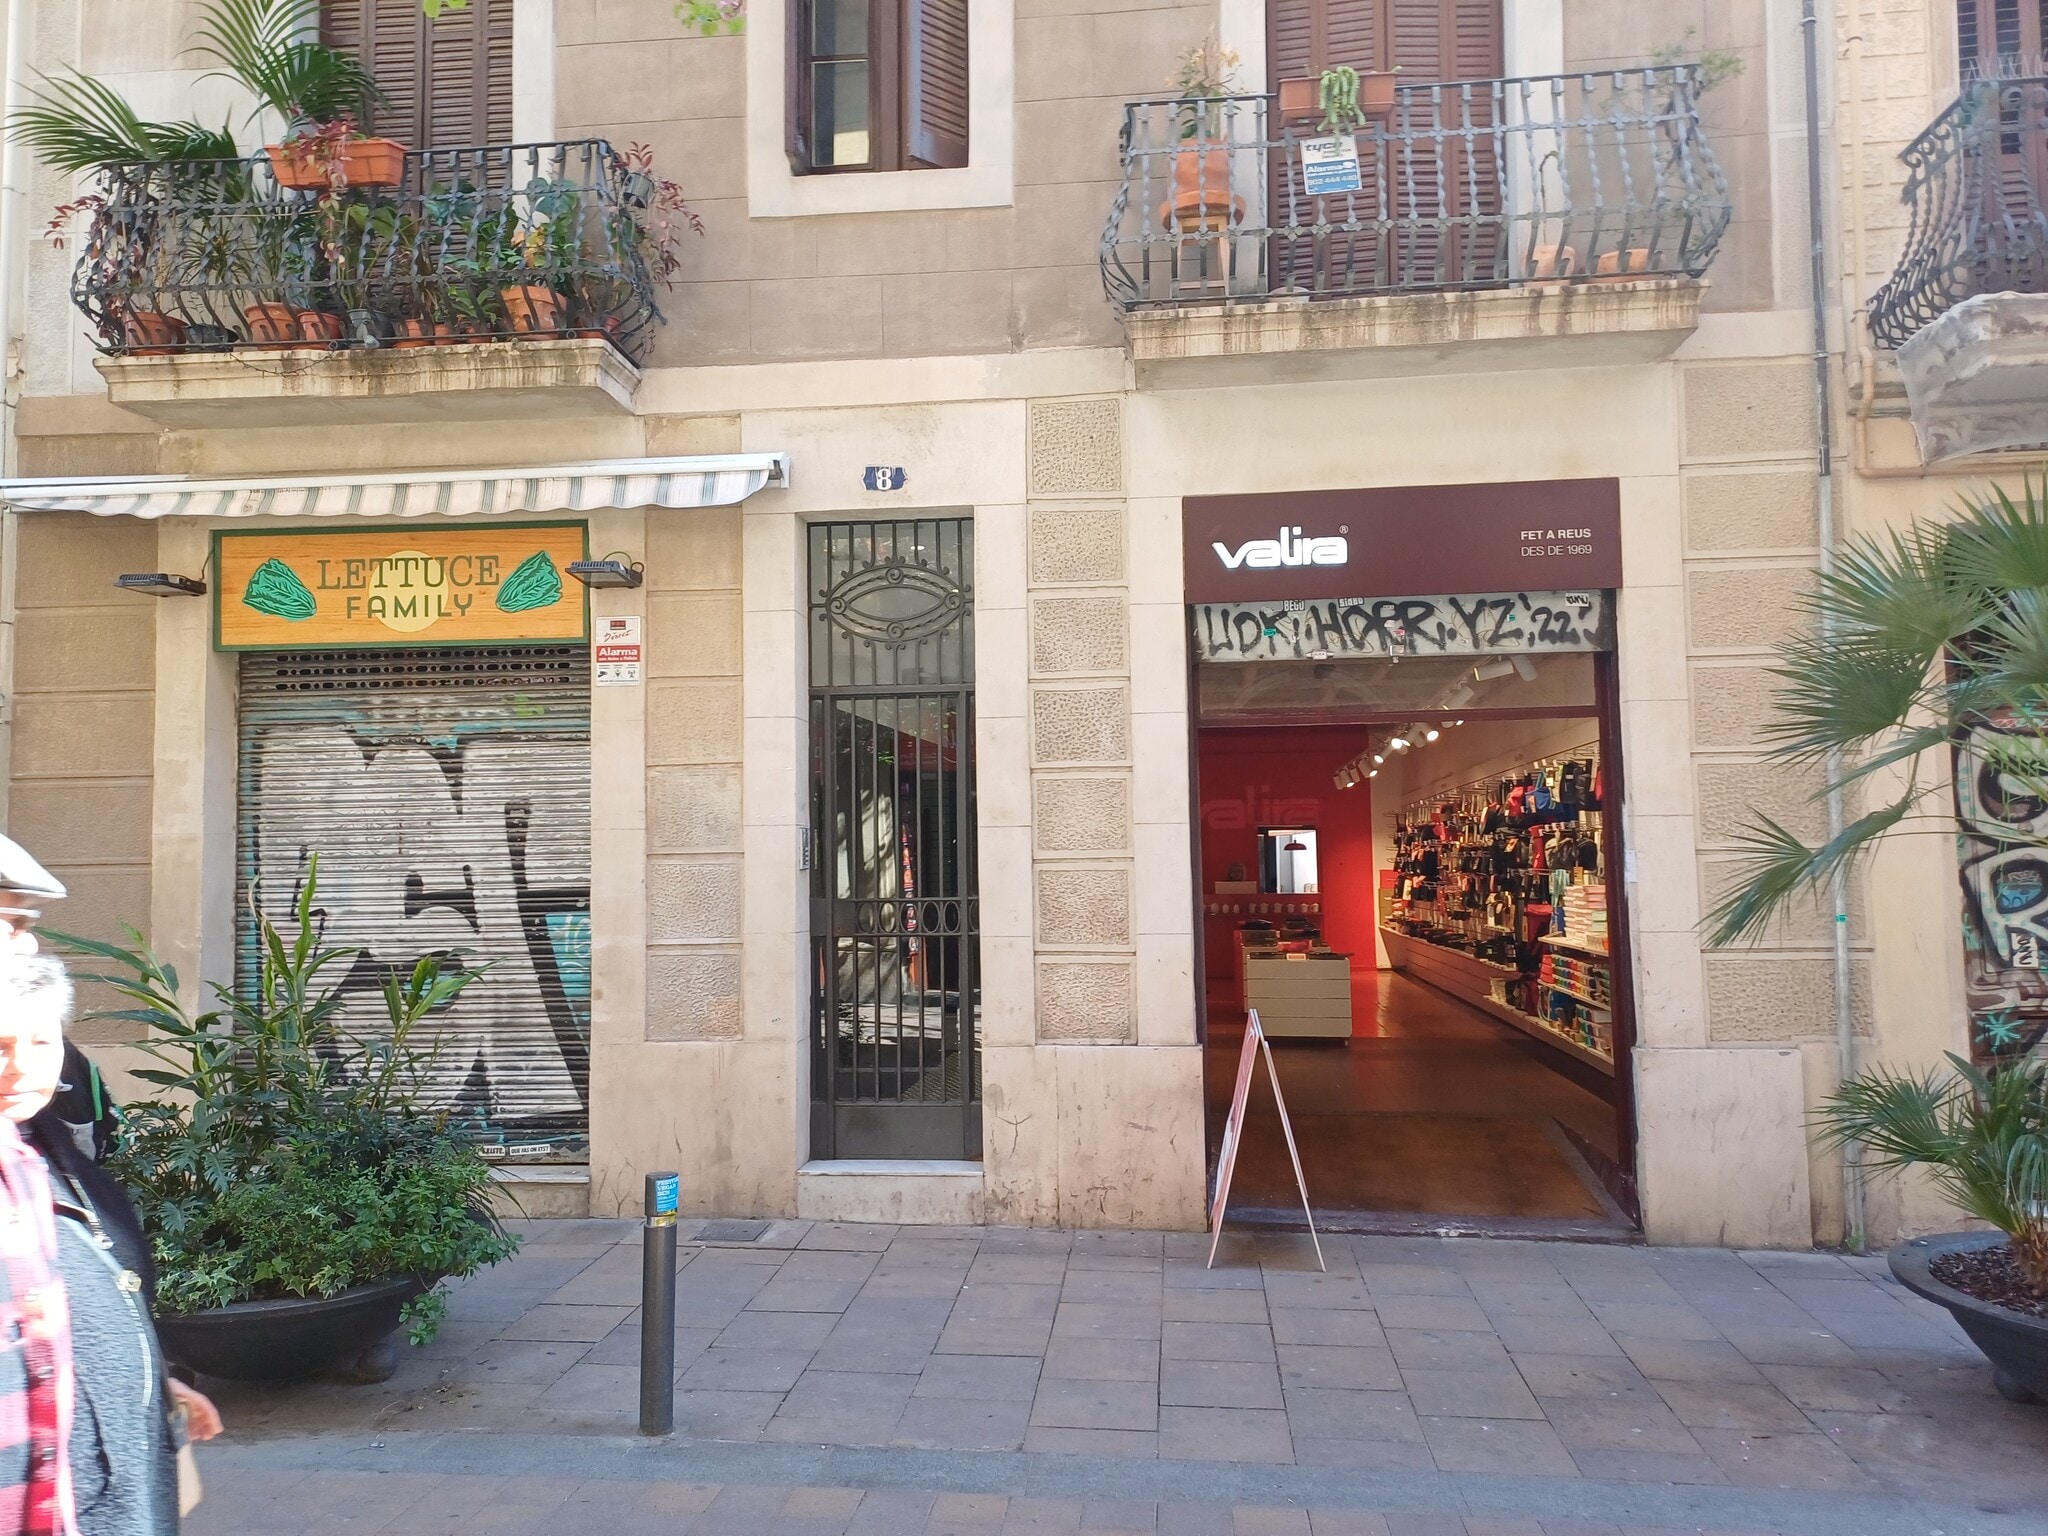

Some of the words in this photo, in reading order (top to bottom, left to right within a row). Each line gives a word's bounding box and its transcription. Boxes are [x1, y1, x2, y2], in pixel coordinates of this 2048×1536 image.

[876, 468, 892, 490] 8
[1520, 530, 1544, 541] FET
[1546, 529, 1556, 540] A
[1557, 528, 1592, 539] REUS
[1211, 526, 1348, 569] valira
[1521, 545, 1545, 557] DES
[1547, 544, 1564, 556] DE
[1566, 544, 1593, 555] 1969
[316, 555, 500, 590] LETTUCE
[346, 593, 473, 619] FAMILY
[599, 646, 638, 656] Alarma
